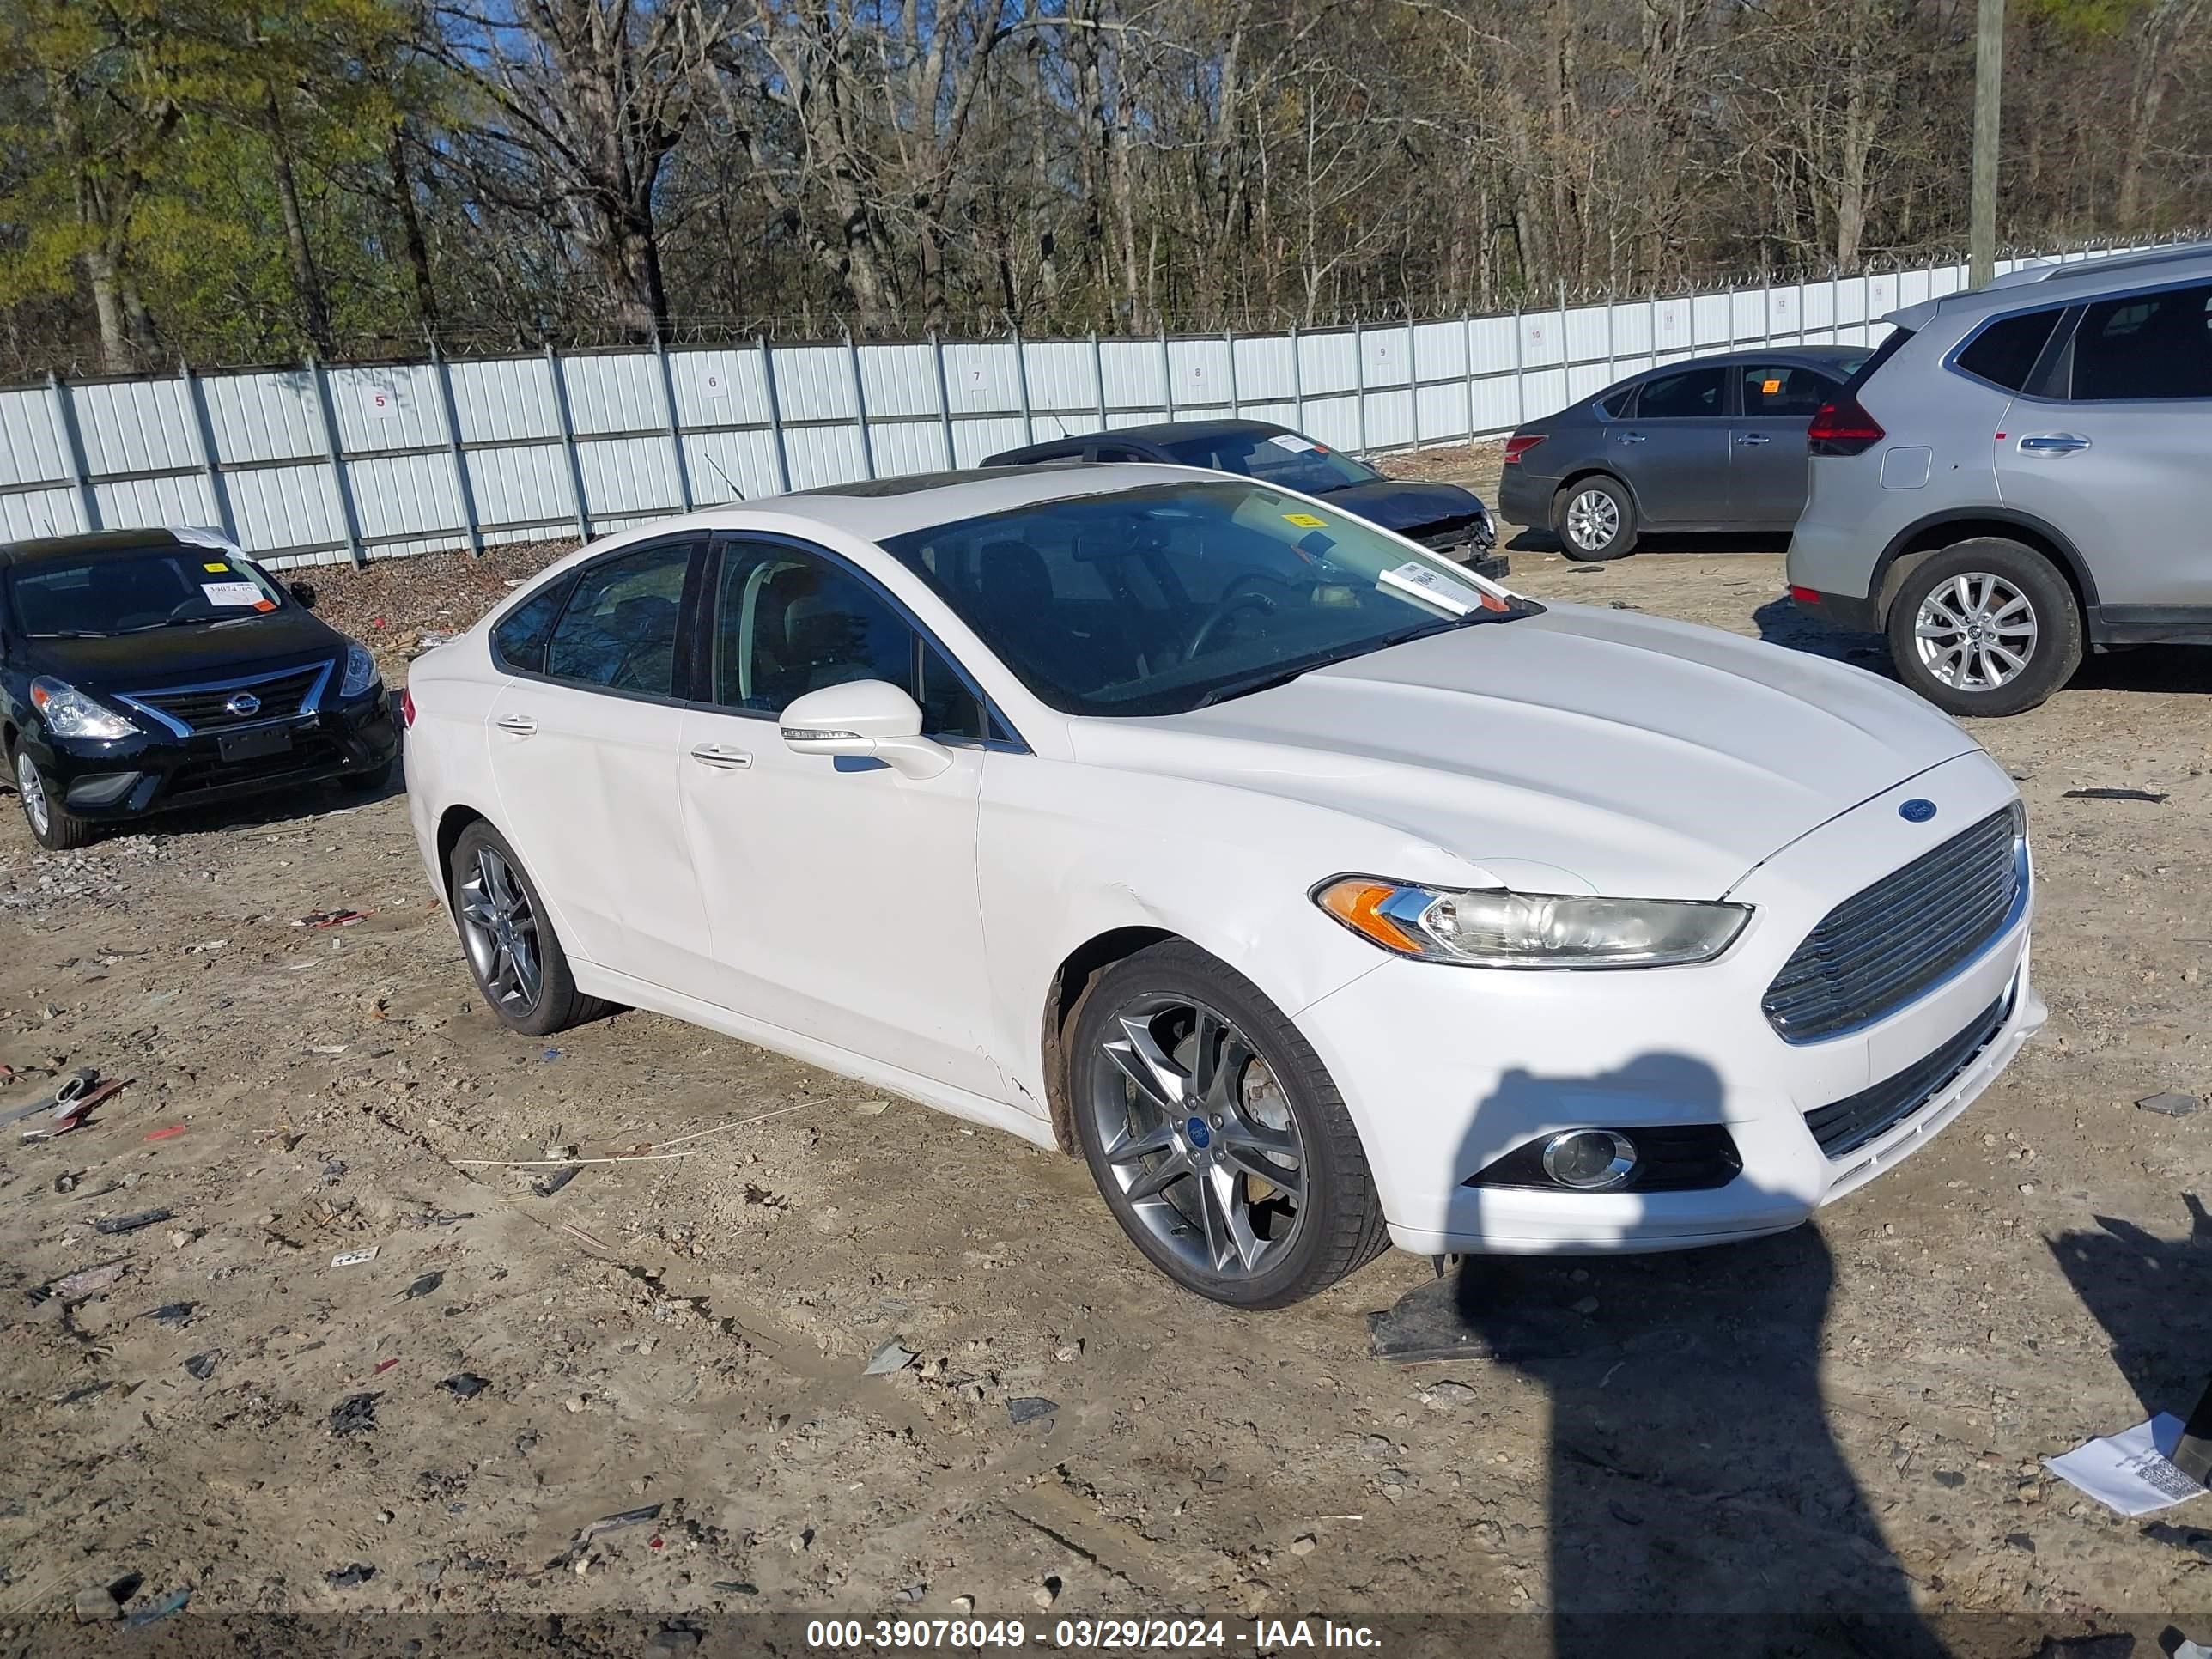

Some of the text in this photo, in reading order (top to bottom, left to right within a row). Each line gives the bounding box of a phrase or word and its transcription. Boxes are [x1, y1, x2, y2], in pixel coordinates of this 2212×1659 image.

[1532, 331, 1540, 339] 10
[973, 371, 981, 381] 7
[1194, 368, 1201, 378] 8
[708, 376, 717, 388] 6
[375, 395, 386, 407] 5
